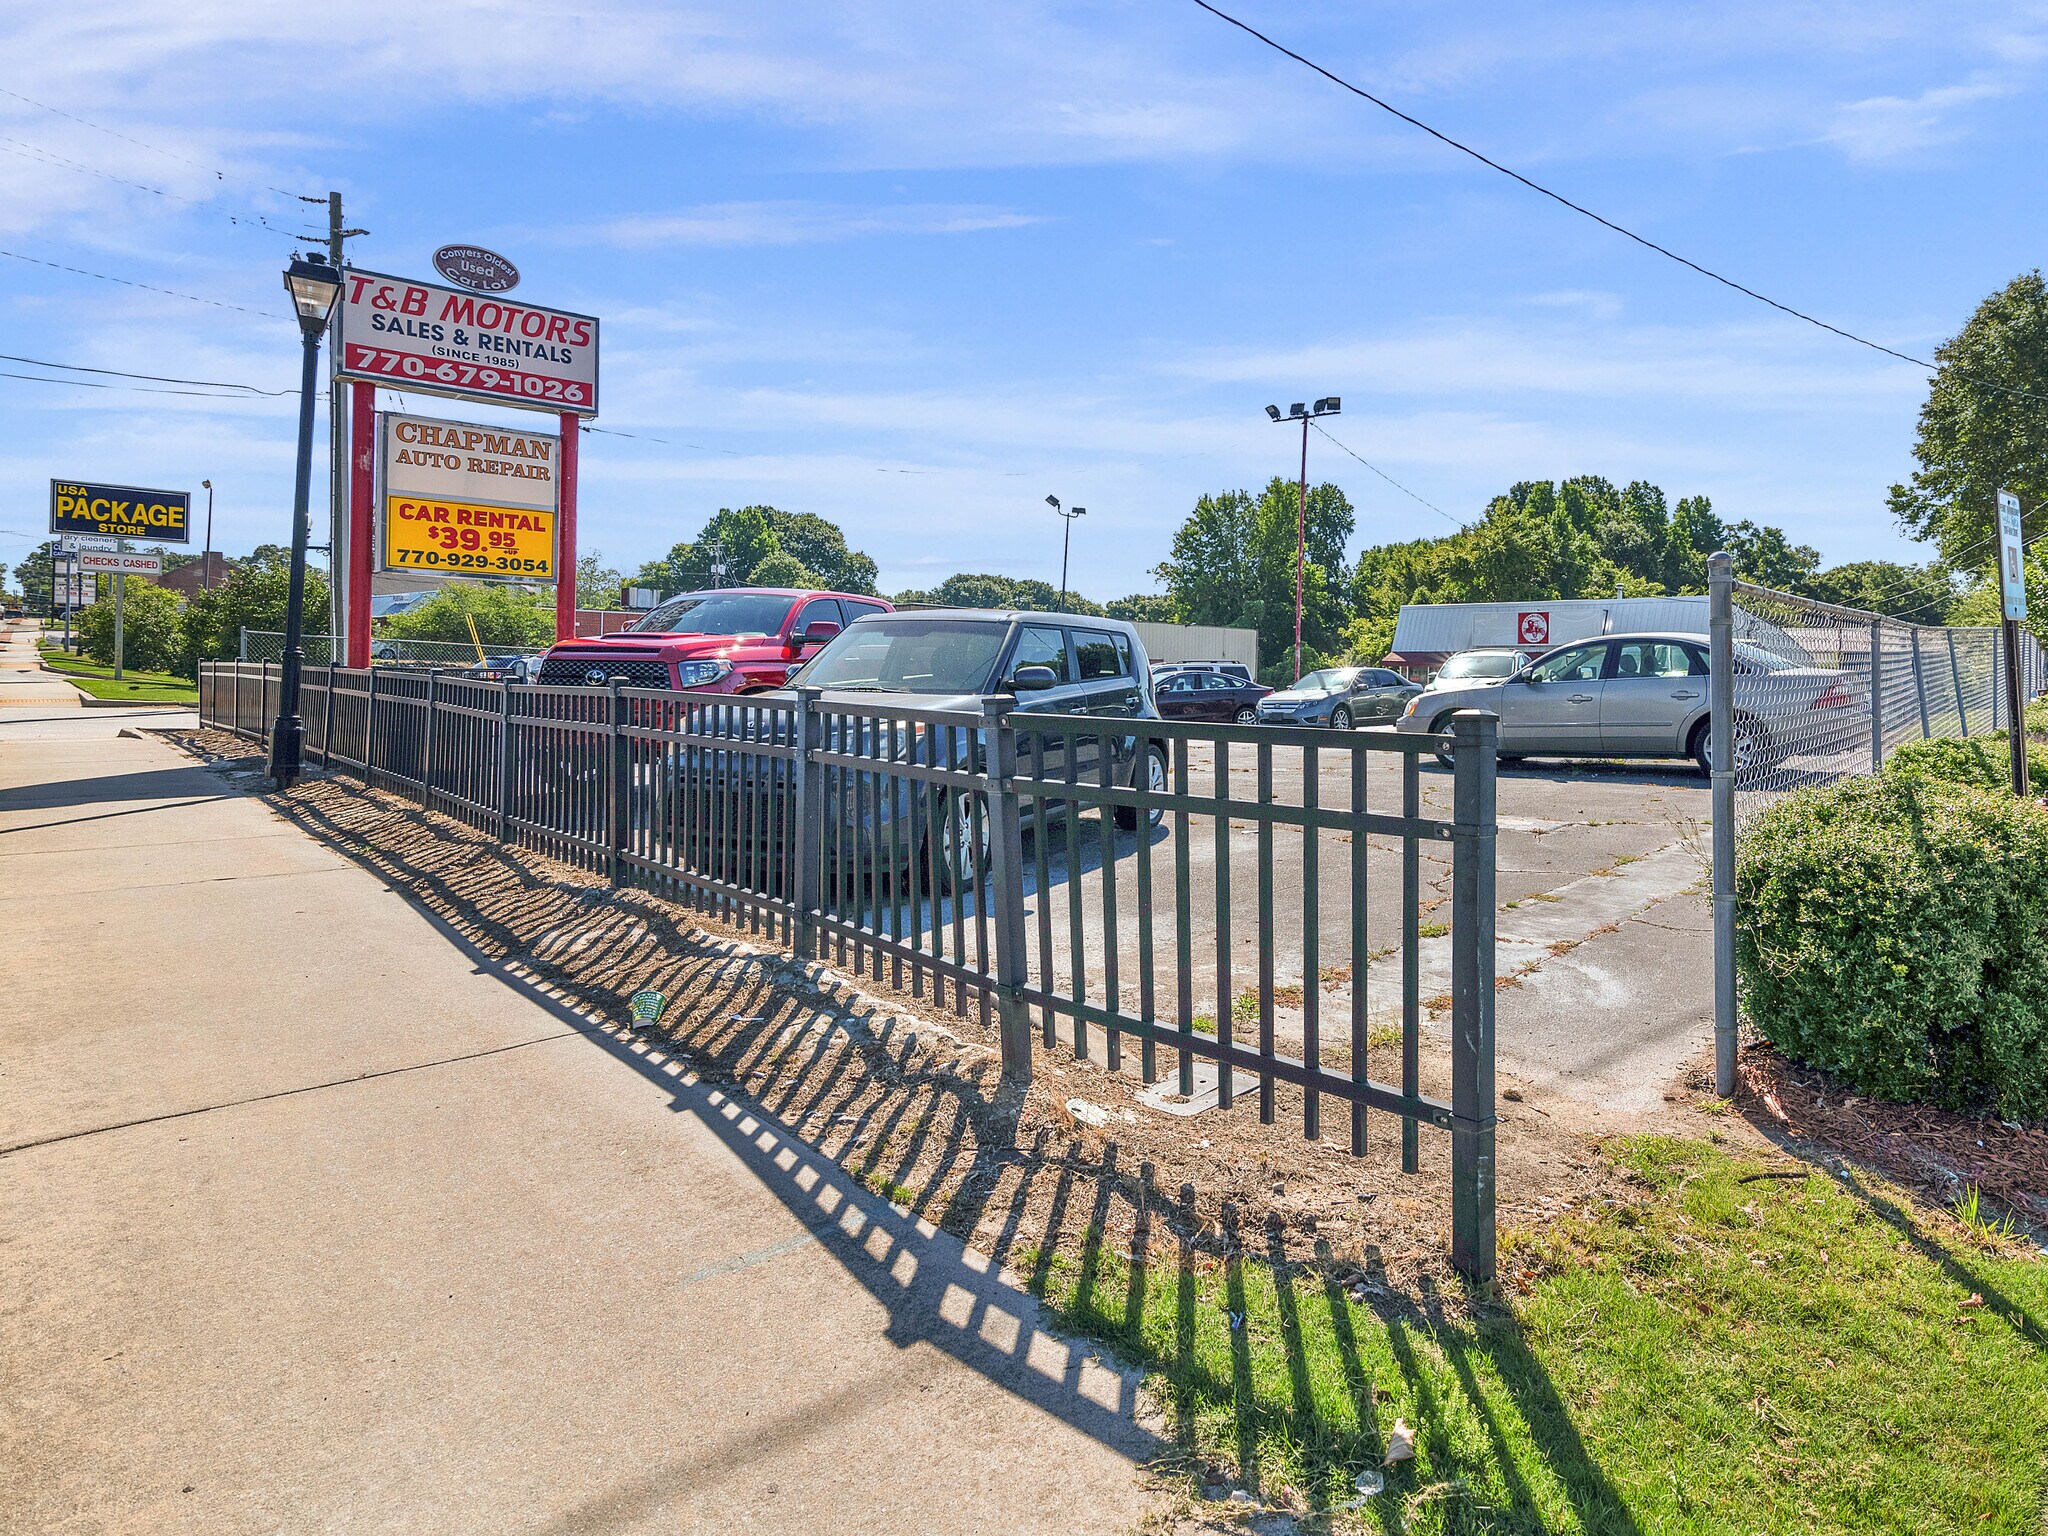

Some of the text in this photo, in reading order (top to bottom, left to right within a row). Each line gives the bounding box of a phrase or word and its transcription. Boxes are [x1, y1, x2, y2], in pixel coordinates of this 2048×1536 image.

[440, 249, 516, 277] Conyers Oldest
[461, 260, 494, 278] Used
[446, 267, 508, 290] Car Lot
[349, 275, 592, 347] T&B MOTORS
[371, 313, 573, 364] SALES & RENTALS
[432, 345, 520, 370] (SINCE 1985)
[356, 347, 584, 402] 770-679-1026
[395, 422, 552, 460] CHAPMAN
[395, 449, 551, 481] AUTO REPAIR
[57, 485, 88, 496] USA
[57, 496, 184, 528] PACKAGE
[399, 503, 546, 533] CAR RENTAL
[63, 533, 117, 543] dry cleaners
[98, 523, 146, 535] STORE
[79, 543, 112, 551] laundry
[83, 556, 158, 569] CHECKS CASHED
[397, 549, 549, 573] 770-929-3054
